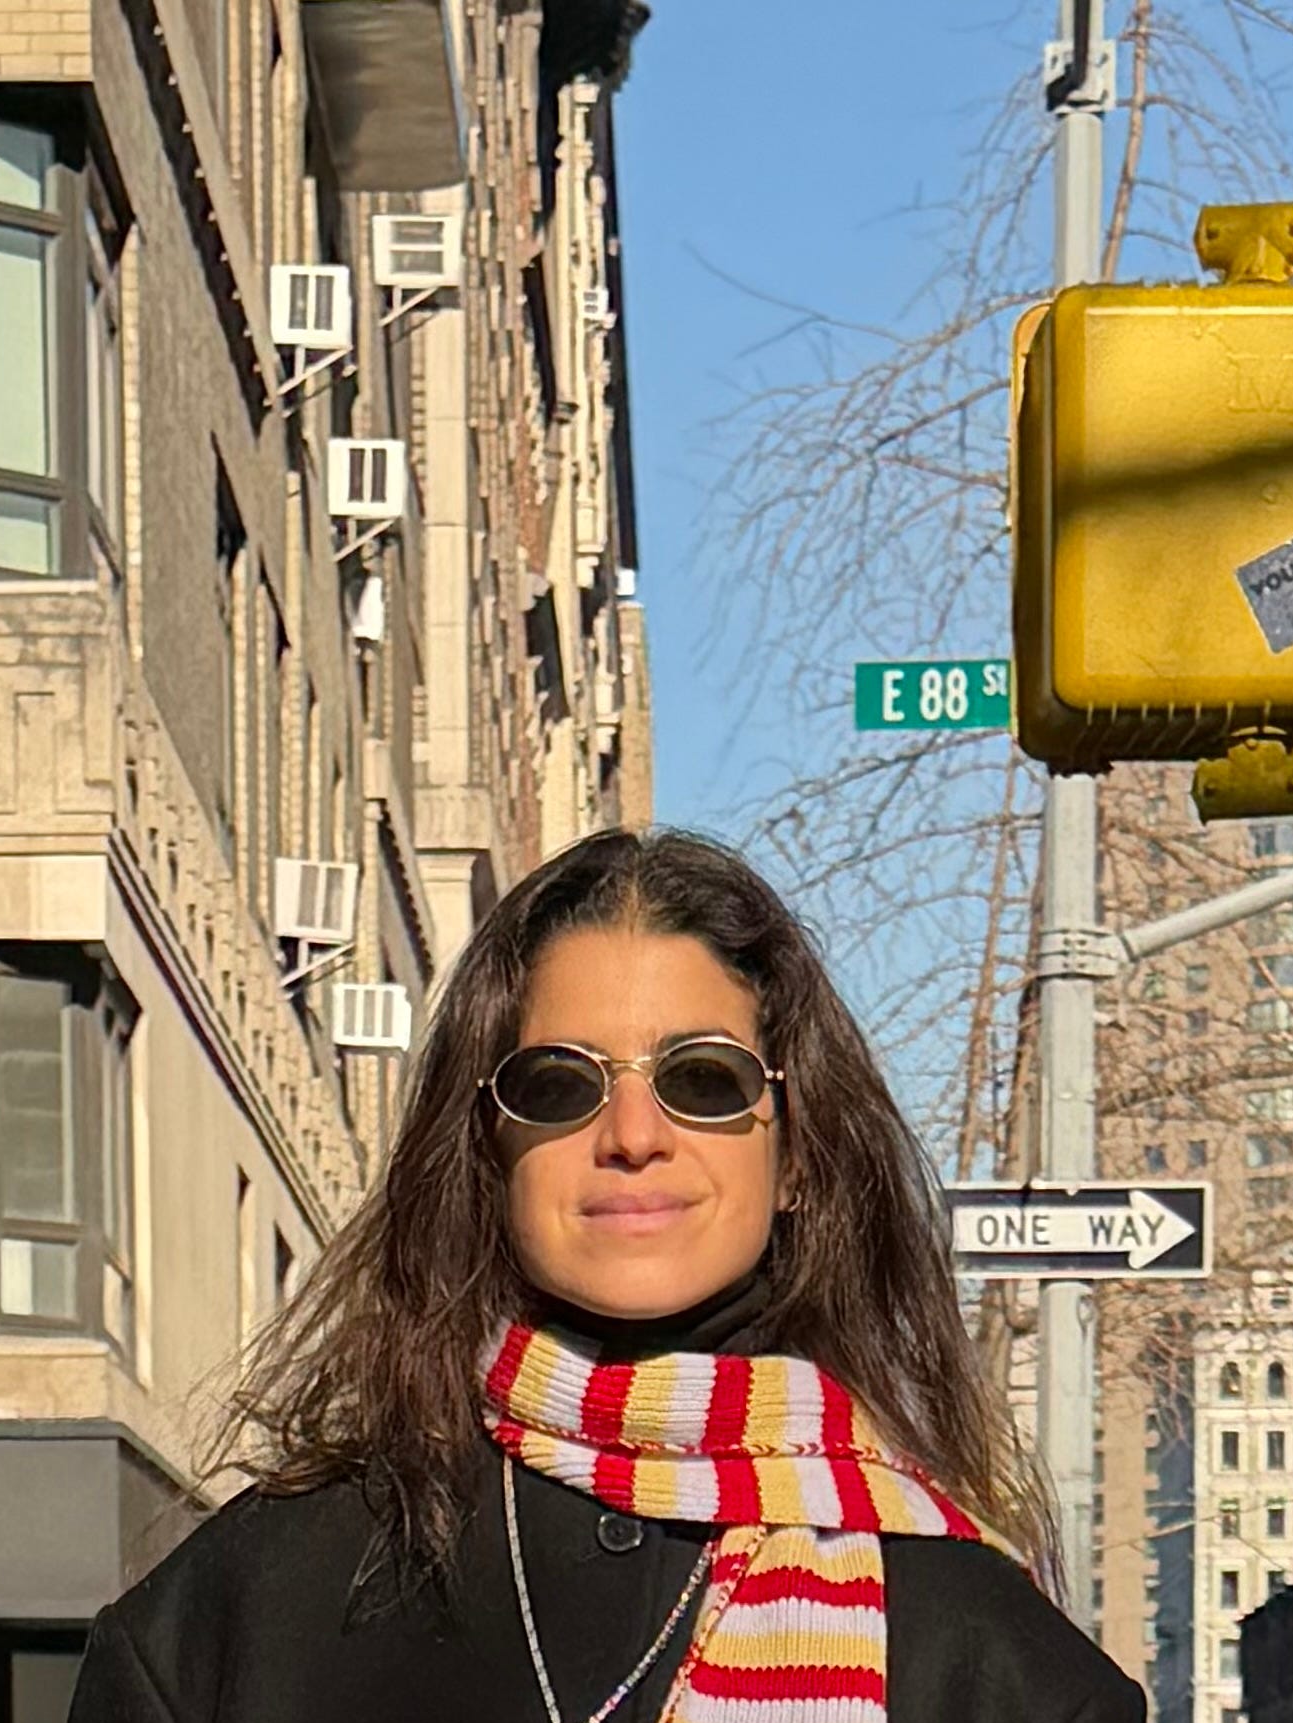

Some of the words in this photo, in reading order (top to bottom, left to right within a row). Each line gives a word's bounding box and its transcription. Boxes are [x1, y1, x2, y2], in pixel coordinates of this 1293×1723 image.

[882, 669, 906, 722] E
[920, 667, 969, 722] 88
[976, 1214, 1052, 1247] ONE
[1088, 1214, 1167, 1248] WAY
